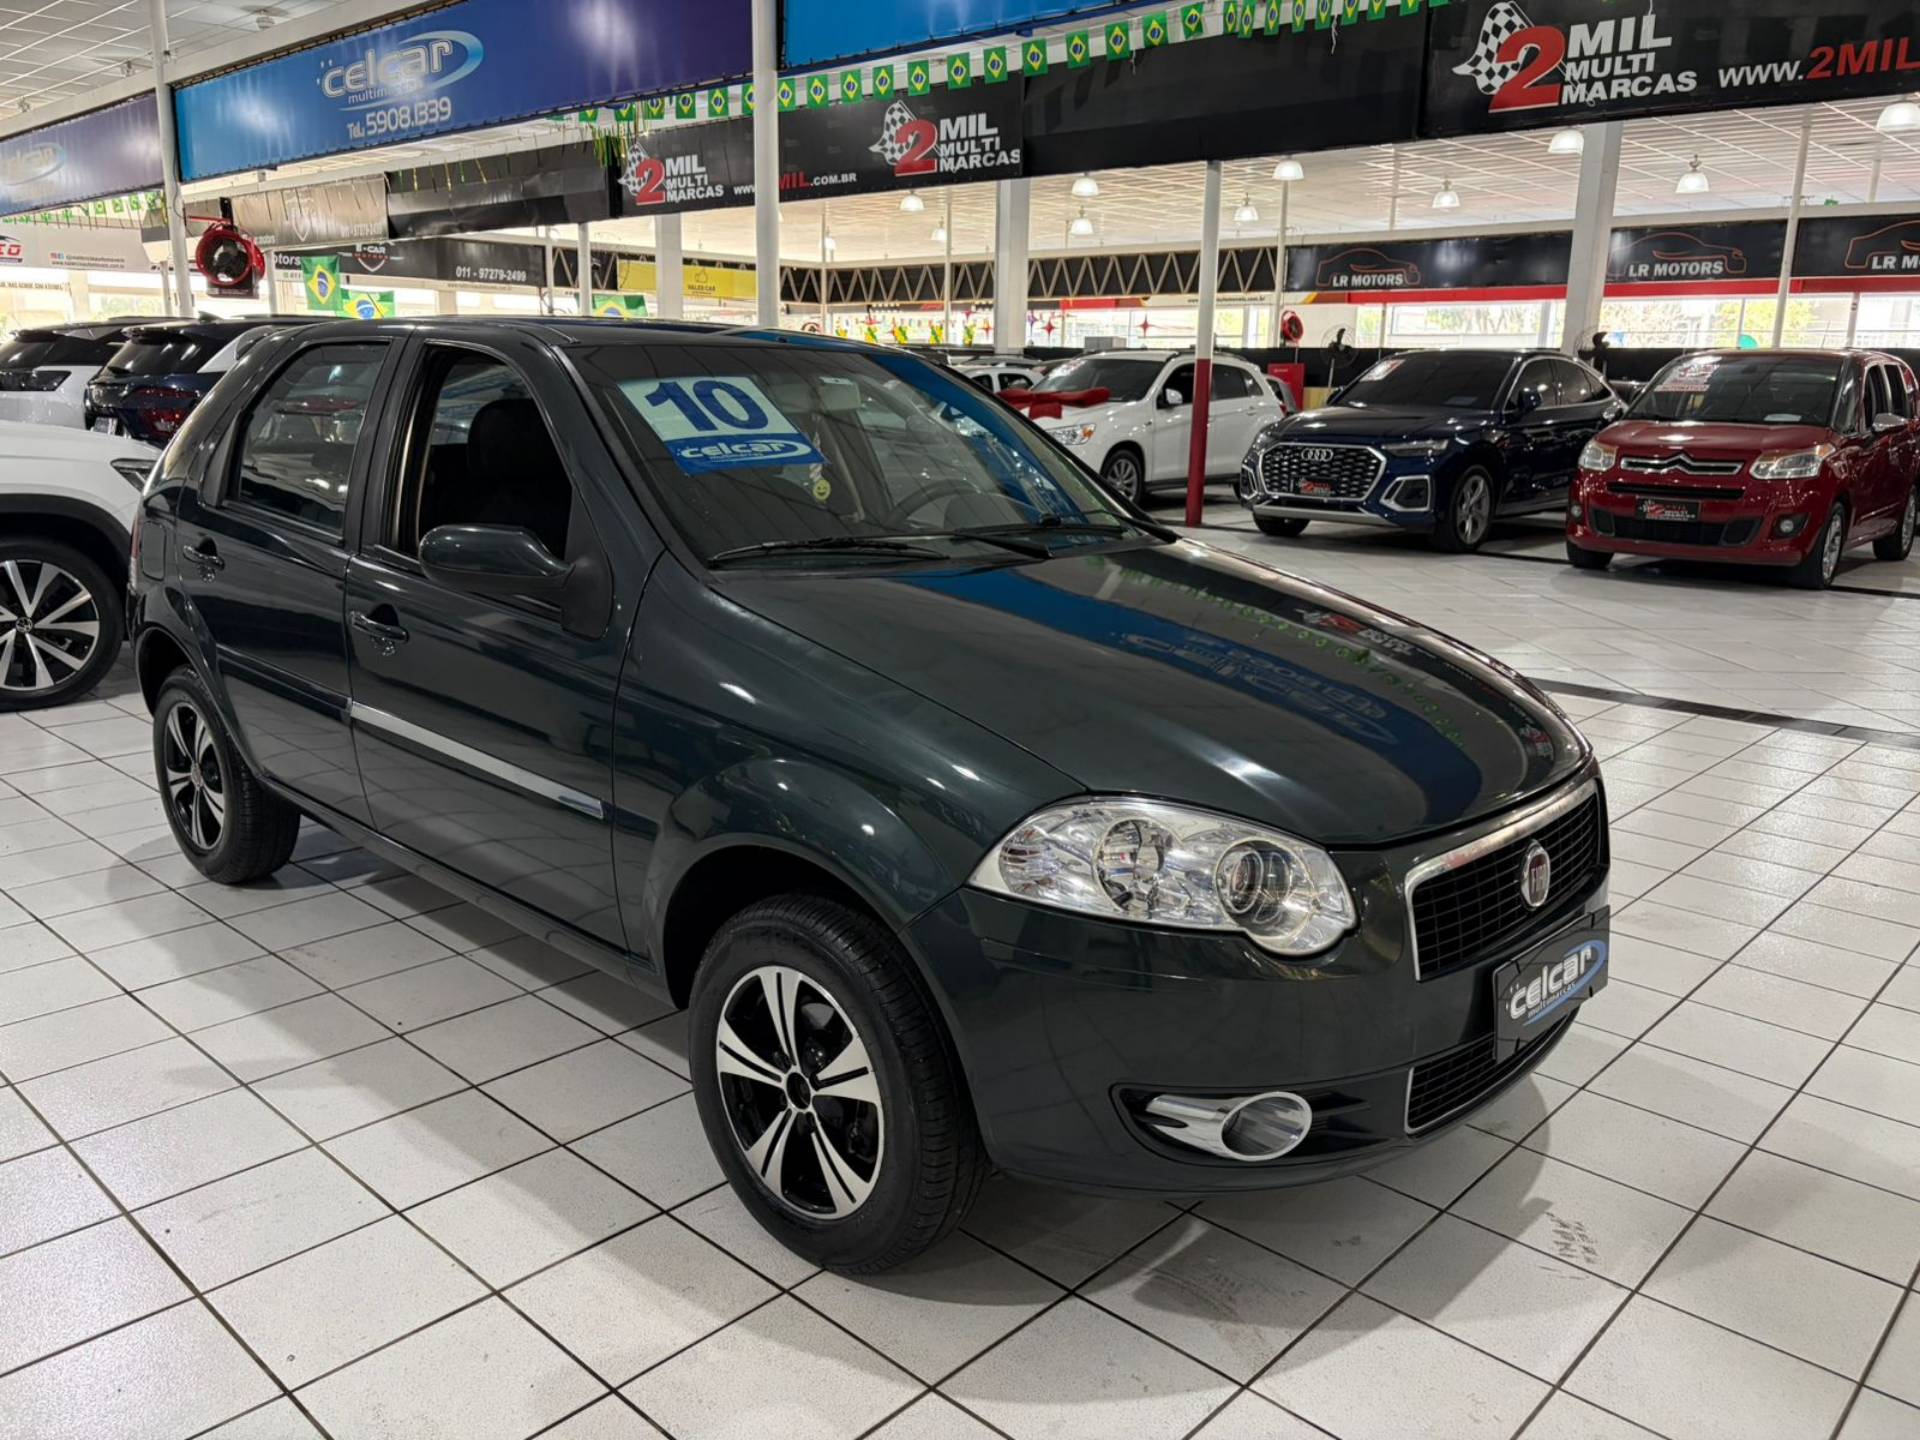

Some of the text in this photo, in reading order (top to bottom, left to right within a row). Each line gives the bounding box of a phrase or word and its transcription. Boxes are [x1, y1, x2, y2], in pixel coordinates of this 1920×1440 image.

[322, 39, 453, 98] celcar
[1488, 14, 1672, 113] 2 MIL
[1565, 52, 1656, 82] MULTI
[1561, 71, 1698, 106] MARCAS
[894, 112, 998, 177] 2 MIL
[940, 136, 1001, 158] MULTI
[940, 149, 1021, 173] MARCAS
[636, 154, 706, 206] 2 MIL
[666, 174, 708, 190] MULTI
[667, 184, 724, 203] MARCAS
[456, 266, 471, 278] 011
[1628, 261, 1724, 278] LR MOTORS
[1871, 254, 1920, 270] LR M
[1333, 273, 1404, 288] LR MOTORS
[645, 380, 769, 432] 10
[681, 442, 786, 459] celcar
[1510, 945, 1592, 1020] celcar
